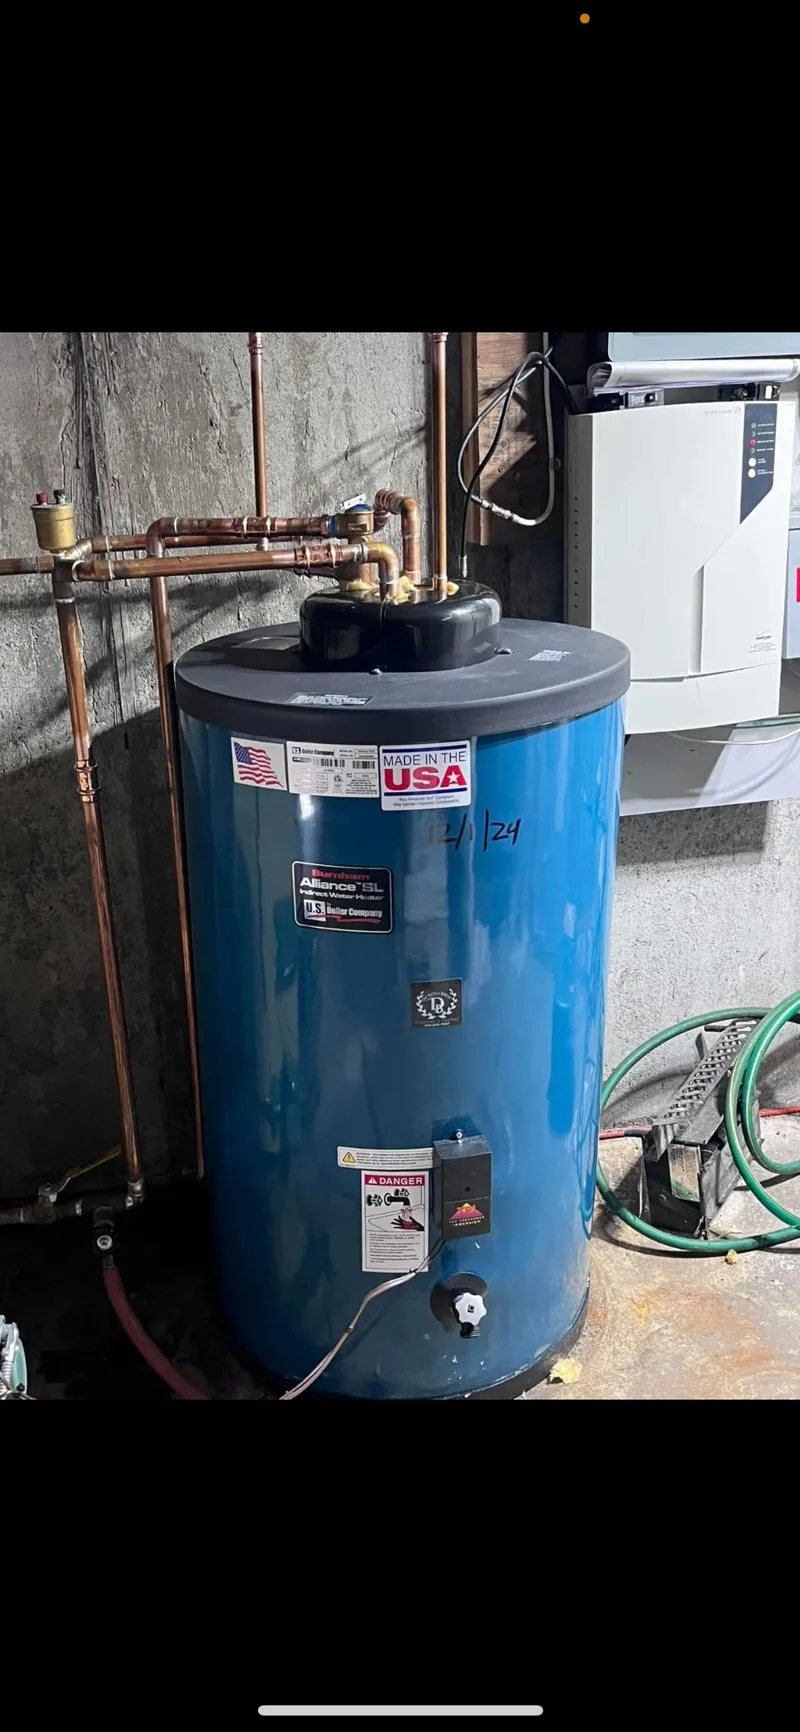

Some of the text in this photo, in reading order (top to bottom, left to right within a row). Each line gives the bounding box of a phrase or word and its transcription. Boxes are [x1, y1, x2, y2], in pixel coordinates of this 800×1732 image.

[383, 751, 466, 767] MADE IN THE
[384, 765, 467, 791] USA
[312, 869, 369, 880] Burnham
[362, 882, 384, 893] SL
[299, 888, 328, 898] Indirect
[329, 891, 355, 899] Water
[306, 901, 383, 918] U.S. Boiler Company
[379, 1177, 423, 1185] DANGER
